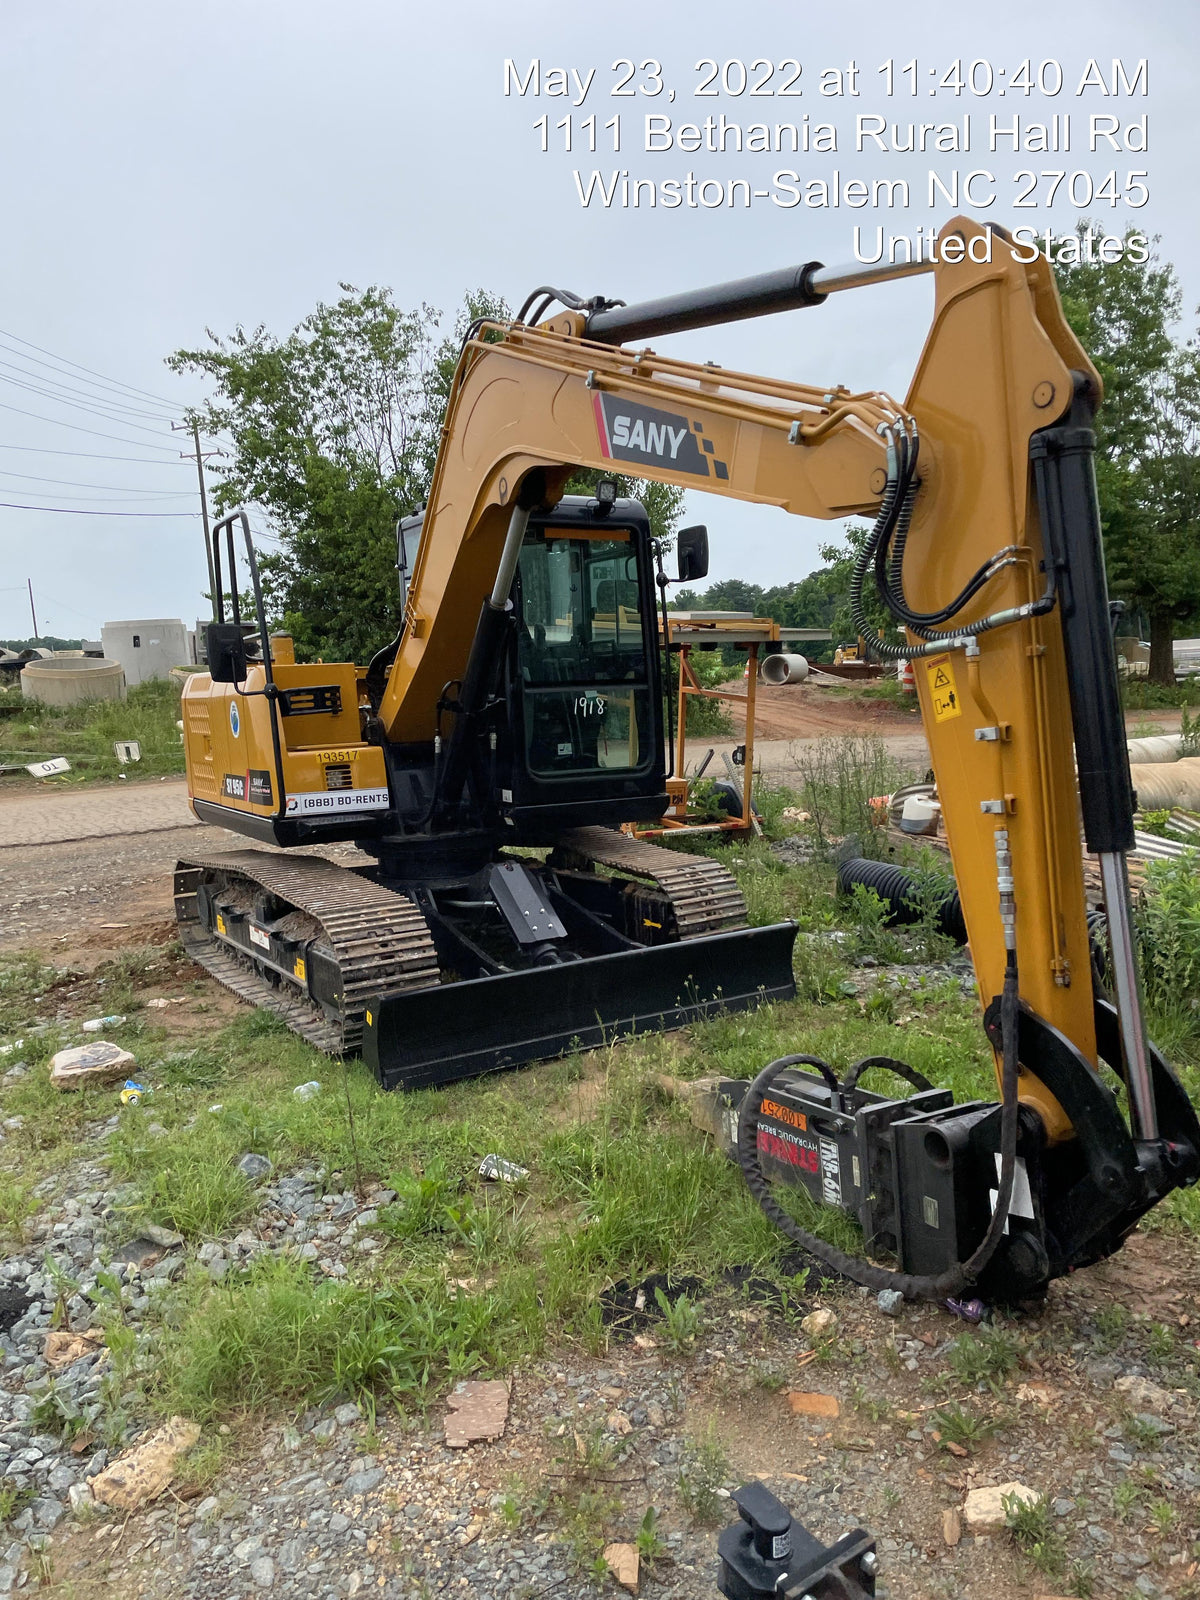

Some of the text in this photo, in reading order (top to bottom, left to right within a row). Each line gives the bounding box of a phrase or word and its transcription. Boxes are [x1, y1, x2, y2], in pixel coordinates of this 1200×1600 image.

[612, 415, 687, 459] SANY
[574, 697, 604, 718] 1918
[317, 750, 358, 762] 193517
[338, 793, 389, 805] 80-RENTS
[756, 1130, 819, 1174] STRIKE
